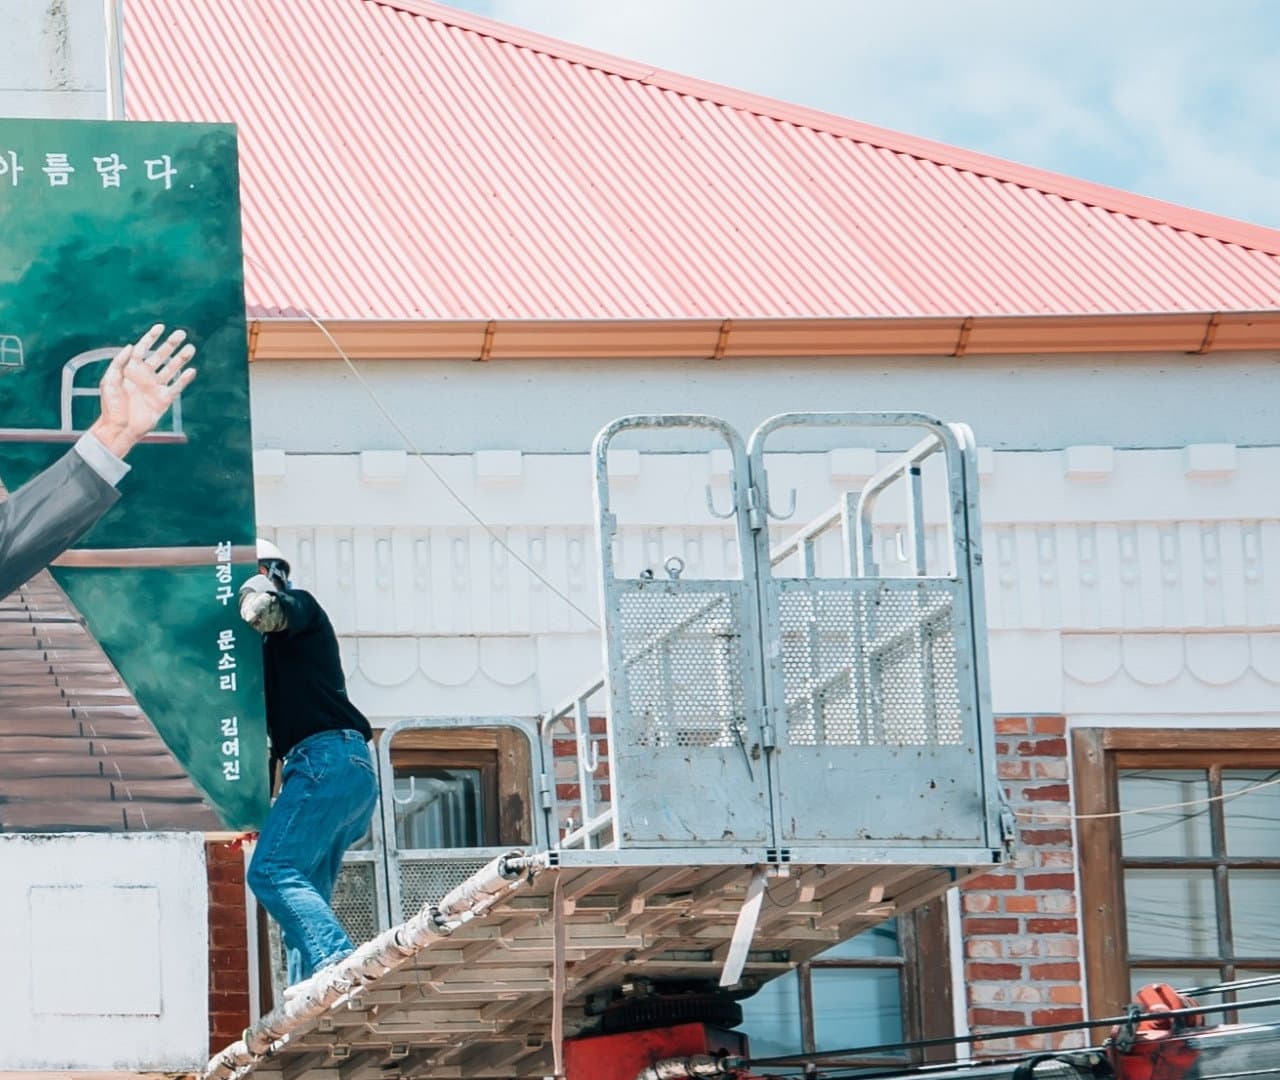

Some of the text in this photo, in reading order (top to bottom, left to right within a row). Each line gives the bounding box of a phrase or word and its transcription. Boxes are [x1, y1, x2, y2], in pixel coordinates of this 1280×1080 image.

[215, 541, 241, 781] 설경구 문소리 김여진
